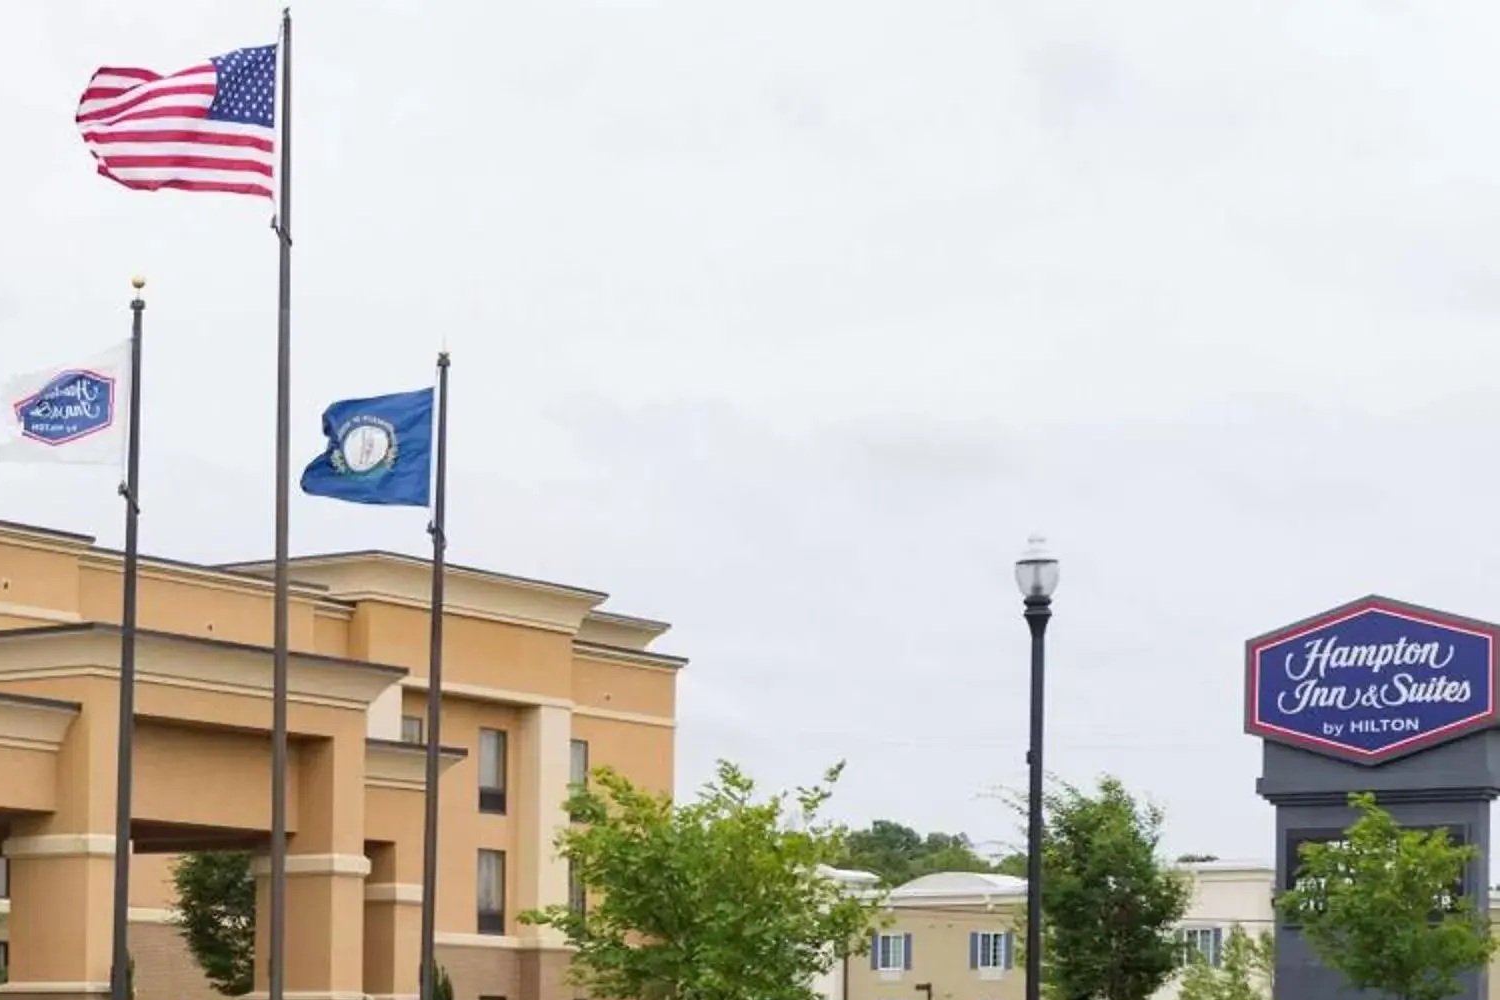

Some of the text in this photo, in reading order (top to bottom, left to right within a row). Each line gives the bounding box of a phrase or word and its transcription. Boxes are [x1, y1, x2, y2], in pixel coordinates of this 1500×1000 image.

[1285, 635, 1455, 681] Hampton
[1277, 672, 1471, 715] Inn & Suites
[1323, 716, 1419, 737] by HILTON
